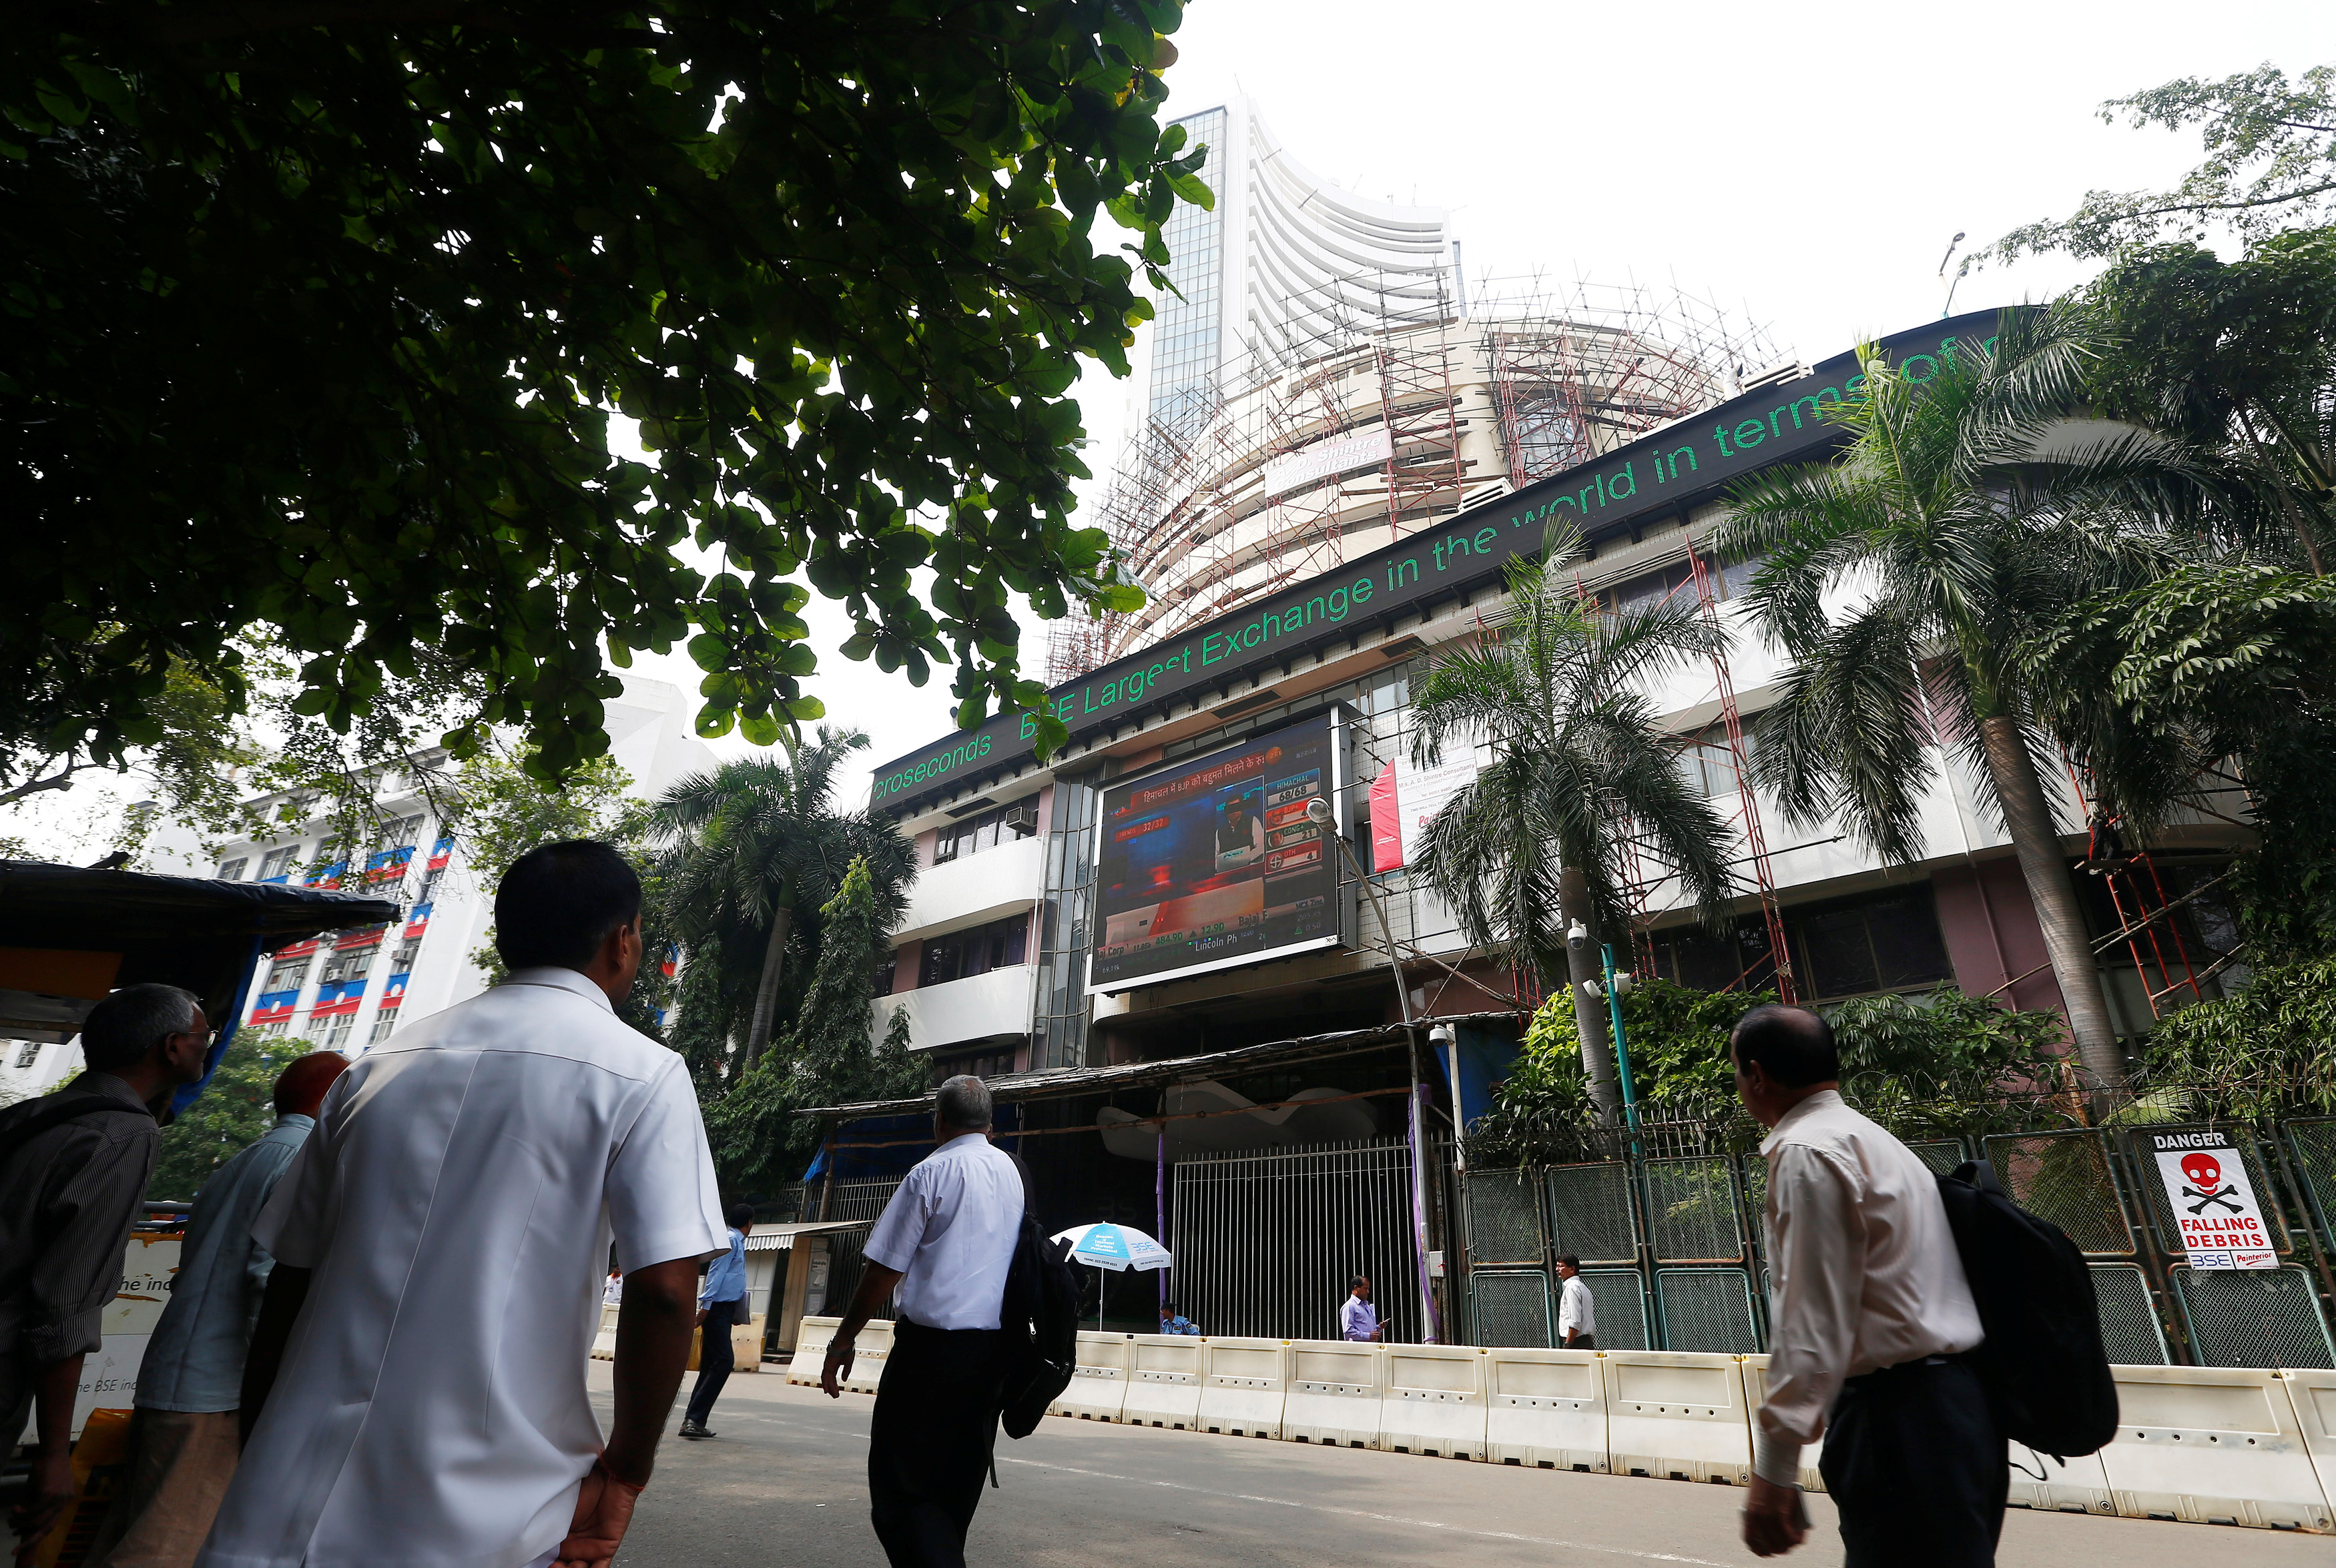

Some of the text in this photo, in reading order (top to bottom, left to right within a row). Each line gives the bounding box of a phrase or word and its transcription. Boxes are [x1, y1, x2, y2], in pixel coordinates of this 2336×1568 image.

[1318, 436, 1383, 462] Shintre
[1202, 577, 1374, 667] Exchange
[1386, 560, 1420, 592] in
[1432, 526, 1498, 571] the
[1653, 449, 1699, 485] in
[1713, 374, 1873, 458] terms
[1902, 336, 1958, 384] of
[1424, 773, 1442, 781] Shintre
[1443, 763, 1475, 776] Consultants
[1178, 781, 1189, 792] BJP
[1191, 774, 1201, 786] को
[1277, 775, 1309, 790] HIMACHAL
[1279, 785, 1307, 802] 68/68
[1284, 804, 1298, 813] BJP+
[1143, 818, 1164, 832] 32/32
[1284, 825, 1304, 835] CONG+
[1302, 829, 1312, 839] 21
[1284, 849, 1296, 857] OTH
[1307, 852, 1313, 860] 4
[1108, 945, 1124, 957] Corp
[1155, 931, 1183, 945] 484.90
[1202, 922, 1225, 935] 12.90
[1238, 912, 1259, 927] Bajaj
[1196, 937, 1223, 951] Lincoln
[1227, 934, 1237, 945] Ph
[2154, 1132, 2228, 1149] DANGER
[2180, 1218, 2259, 1231] FALLING
[2186, 1234, 2264, 1248] DEBRIS
[2191, 1252, 2272, 1266] BSE Painterior
[121, 1276, 141, 1291] he
[93, 1379, 119, 1392] BSE
